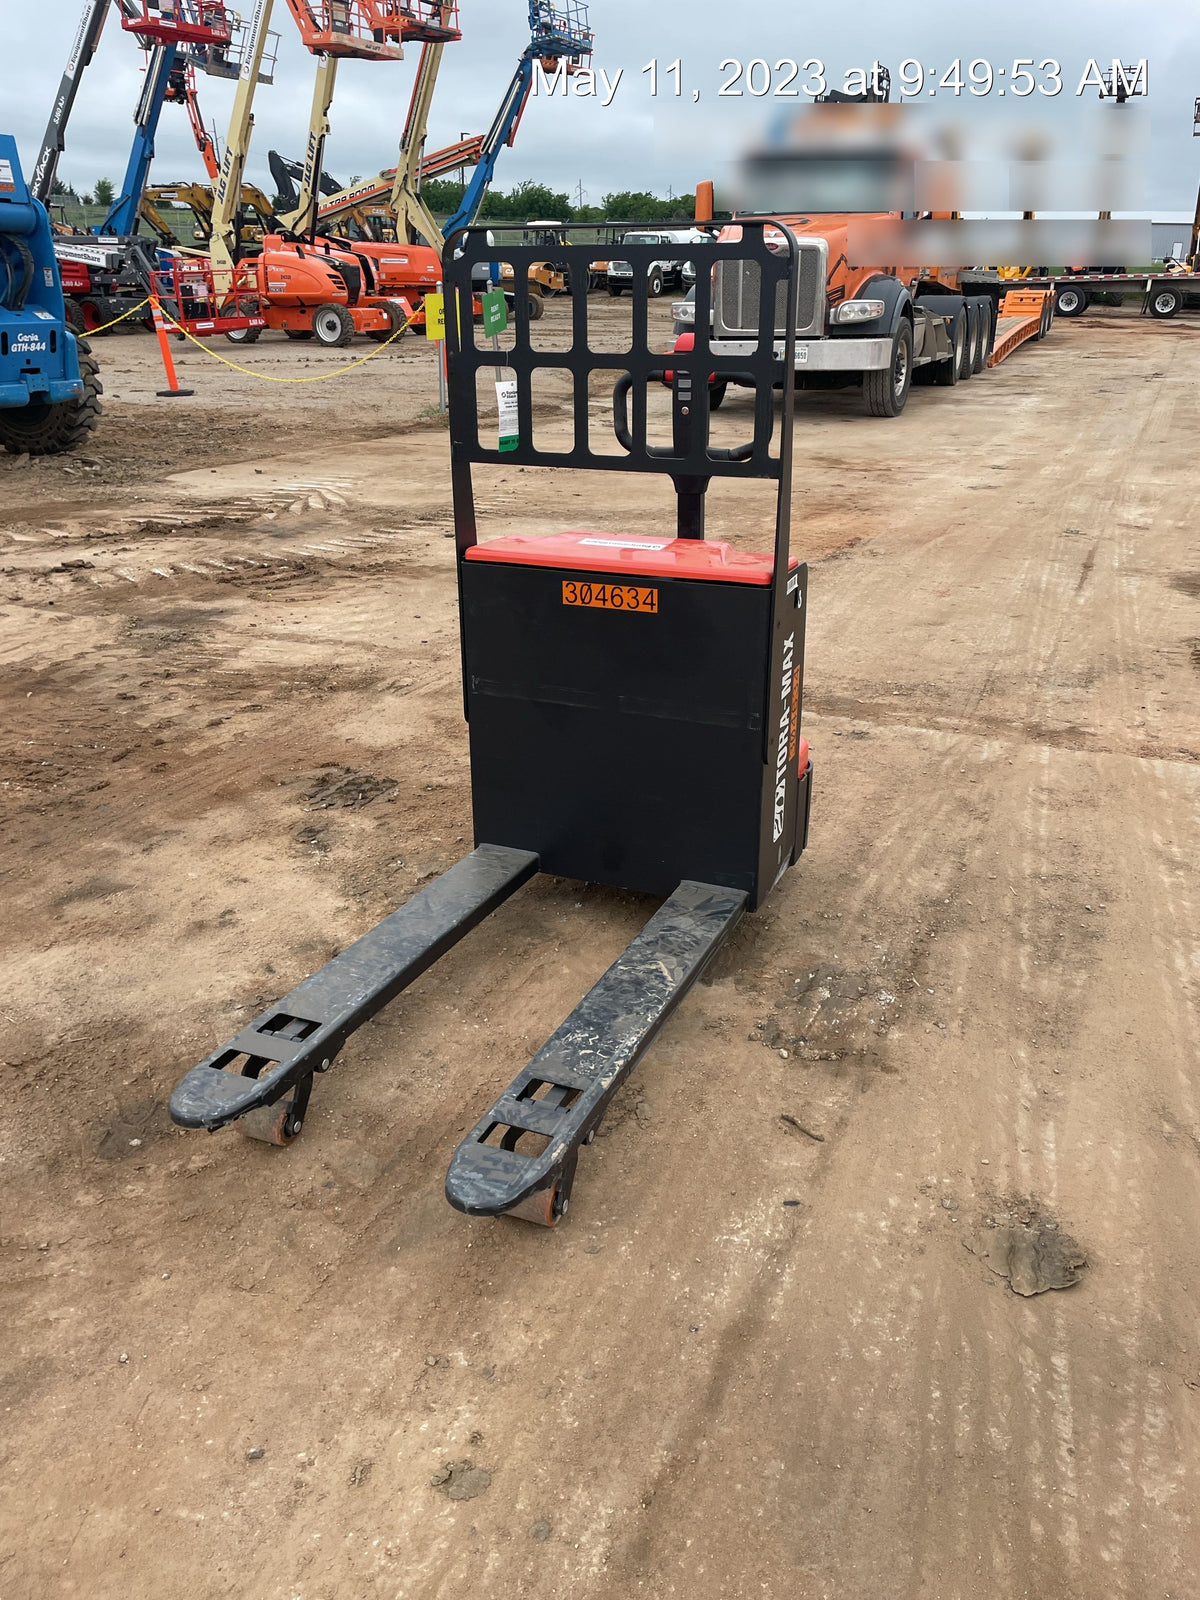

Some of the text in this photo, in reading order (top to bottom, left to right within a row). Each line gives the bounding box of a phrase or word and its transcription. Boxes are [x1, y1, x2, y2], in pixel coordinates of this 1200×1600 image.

[245, 0, 264, 65] EquipmentShar
[31, 146, 51, 198] SKYJACK
[217, 146, 233, 205] JLG LIFT
[304, 131, 317, 188] JLG LIFT
[11, 342, 46, 352] GTH-844
[17, 333, 39, 342] Genie
[565, 582, 657, 611] 304634
[775, 631, 795, 785] TORA-MAX
